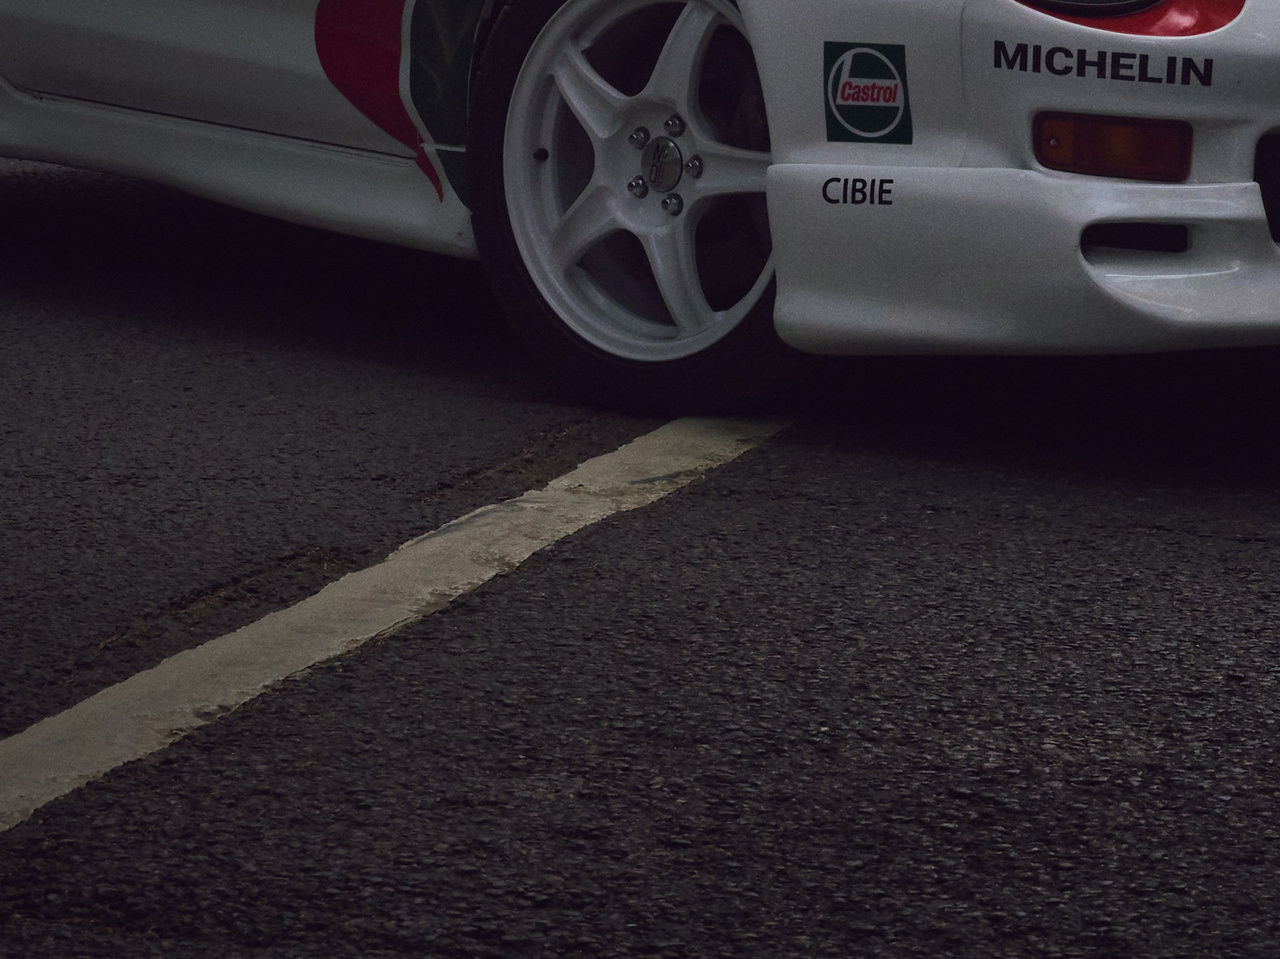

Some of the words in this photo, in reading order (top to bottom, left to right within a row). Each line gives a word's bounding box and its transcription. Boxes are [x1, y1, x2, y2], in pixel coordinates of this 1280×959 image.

[993, 40, 1214, 87] MICHELIN
[839, 79, 899, 106] Castrol
[822, 176, 895, 206] CIBIE
